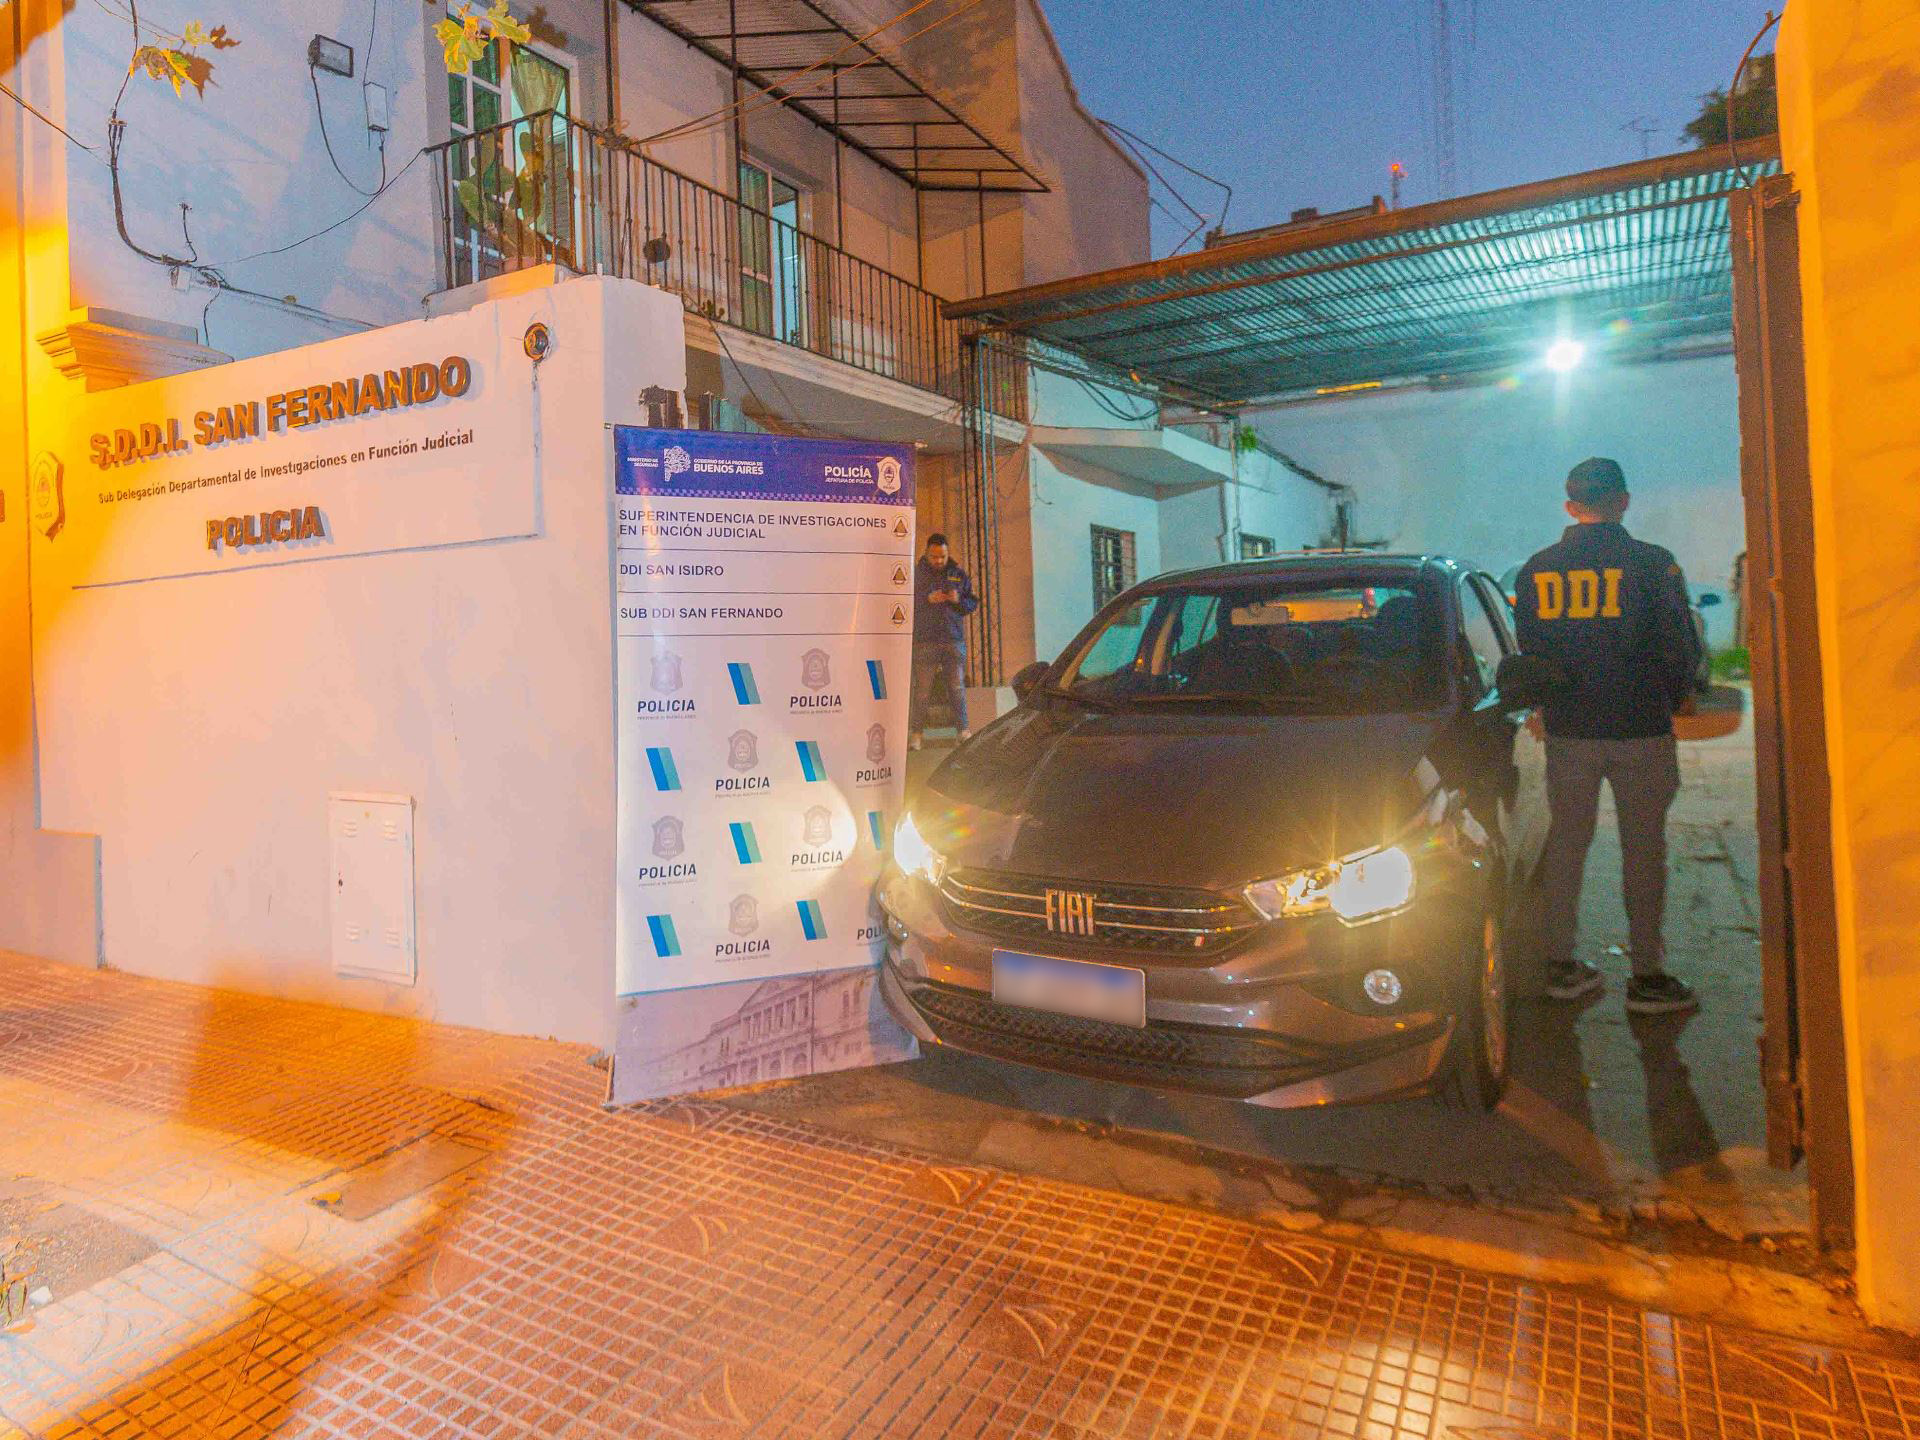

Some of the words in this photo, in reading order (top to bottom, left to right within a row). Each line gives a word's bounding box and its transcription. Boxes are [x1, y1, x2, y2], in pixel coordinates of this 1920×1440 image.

[194, 401, 259, 445] SAN
[267, 355, 472, 431] FERNANDO
[98, 492, 115, 504] Sub
[117, 482, 166, 501] Delegación
[169, 470, 241, 493] Departamental
[244, 468, 257, 480] de
[260, 454, 347, 479] Investigaciones
[351, 451, 365, 462] en
[369, 438, 418, 460] Función
[422, 429, 474, 451] Judicial
[693, 463, 735, 474] BUENOS
[735, 465, 764, 475] AIRES
[824, 465, 873, 479] POLICÍA
[619, 509, 755, 525] SUPERINTENDENCIA
[758, 514, 775, 526] DE
[778, 514, 887, 529] INVESTIGACIONES
[207, 505, 326, 551] POLICIA
[619, 525, 637, 536] EN
[641, 523, 703, 537] FUNCIÓN
[706, 527, 766, 540] JUDICIAL
[620, 564, 642, 576] DDI
[646, 564, 674, 576] SAN
[678, 564, 724, 577] ISIDRO
[1533, 568, 1623, 620] DDI
[620, 607, 648, 619] SUB
[651, 607, 676, 619] DDI
[679, 607, 708, 619] SAN
[711, 607, 784, 619] FERNANDO
[637, 699, 695, 713] POLICIA
[790, 694, 842, 708] POLICIA
[856, 766, 892, 782] POLICIA
[715, 776, 770, 791] POLICIA
[791, 850, 843, 866] POLICIA
[639, 863, 697, 880] POLICIA
[1045, 888, 1097, 936] FIAT
[857, 927, 882, 940] POLI
[715, 939, 770, 957] POLICIA
